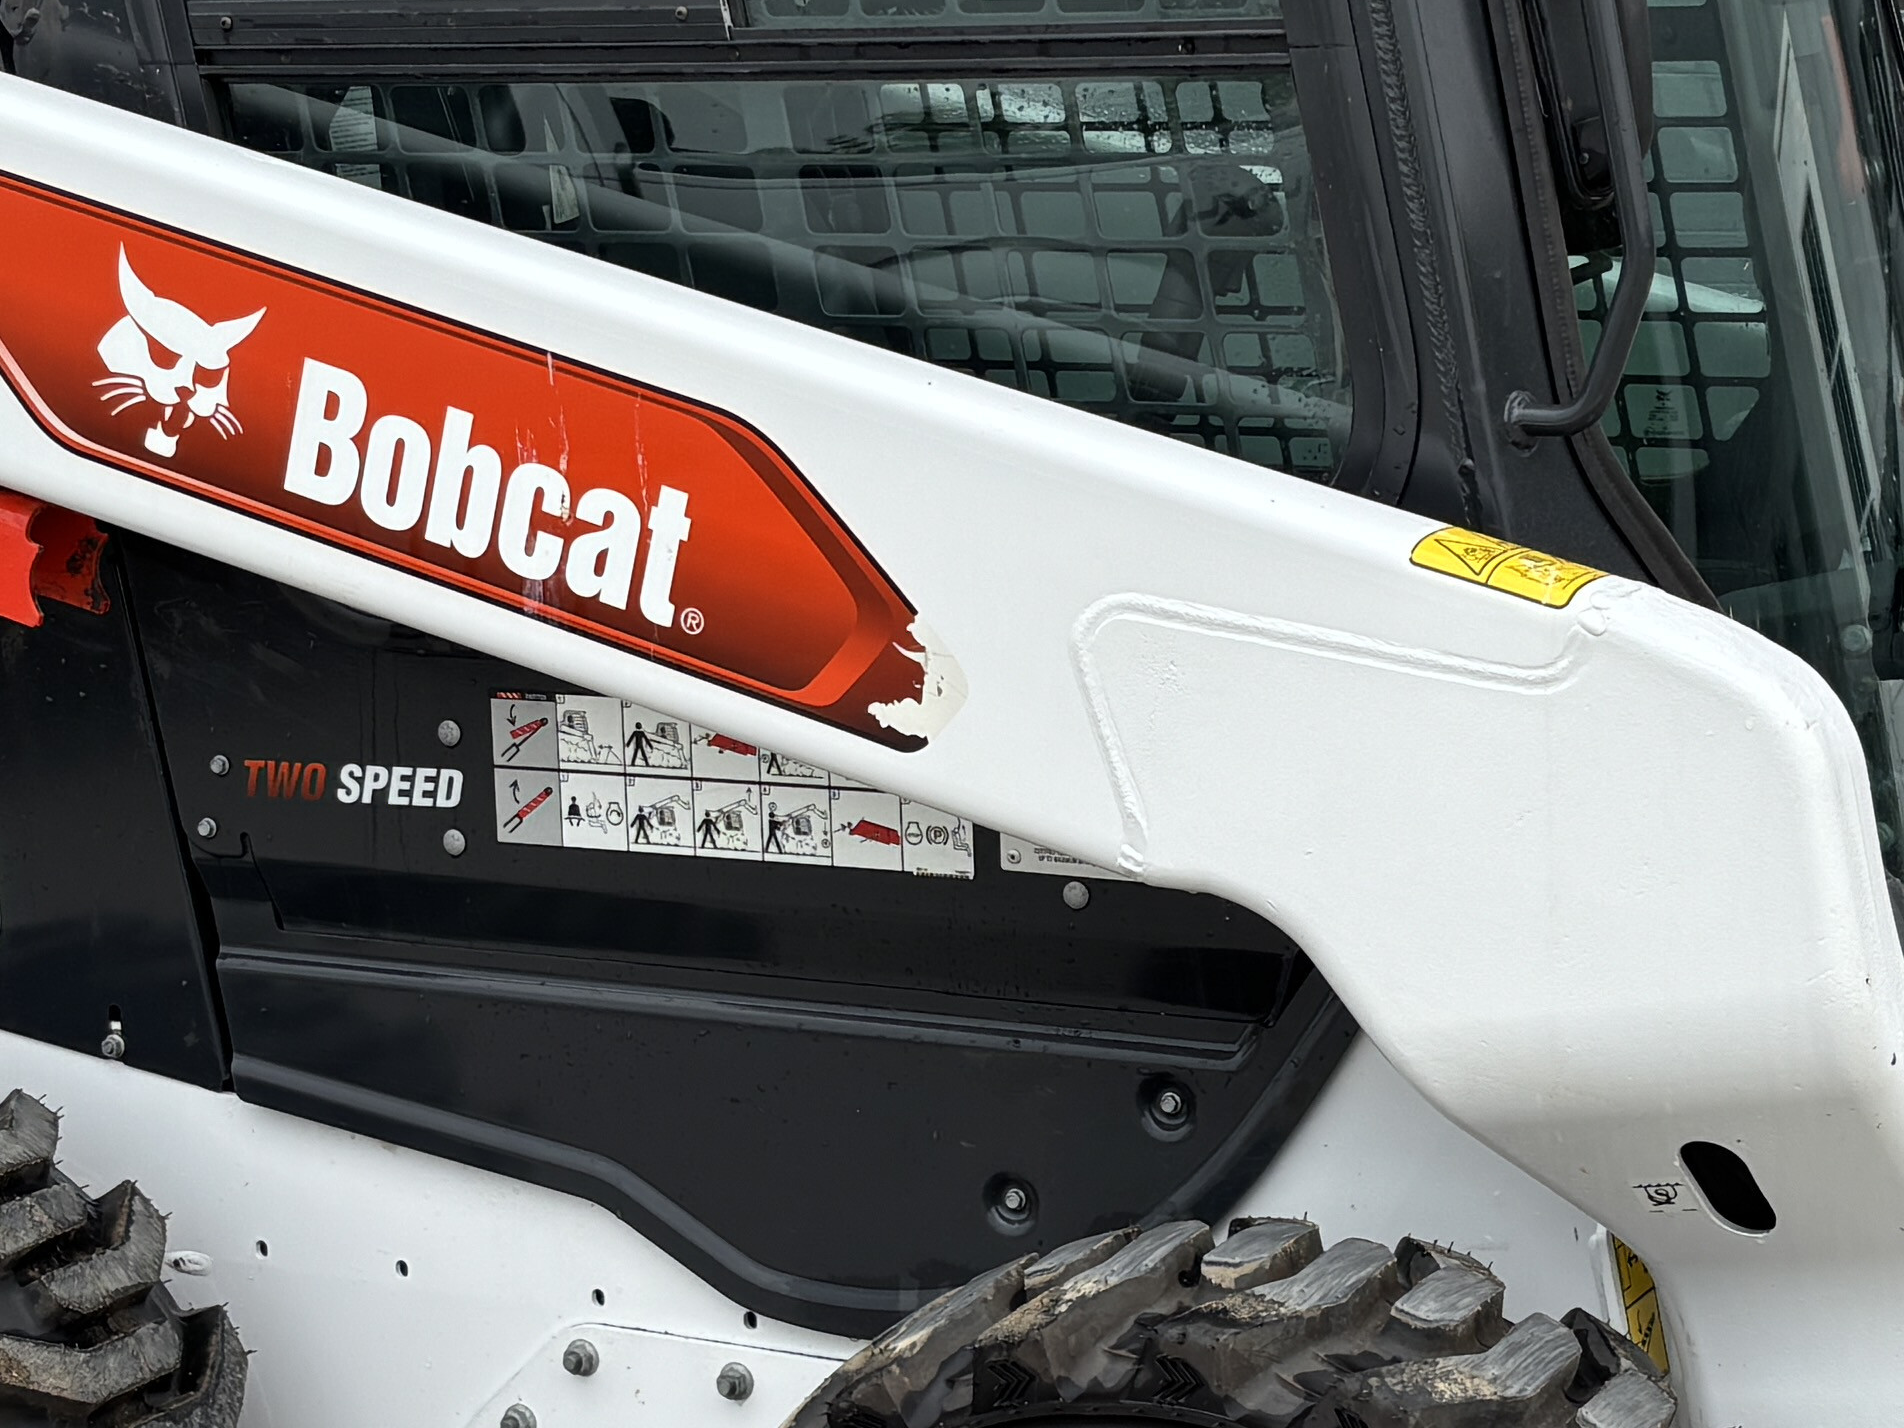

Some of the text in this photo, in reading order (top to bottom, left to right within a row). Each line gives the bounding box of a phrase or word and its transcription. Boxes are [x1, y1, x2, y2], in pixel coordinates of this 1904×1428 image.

[282, 355, 694, 629] Bobcat
[243, 759, 464, 810] TWO SPEED
